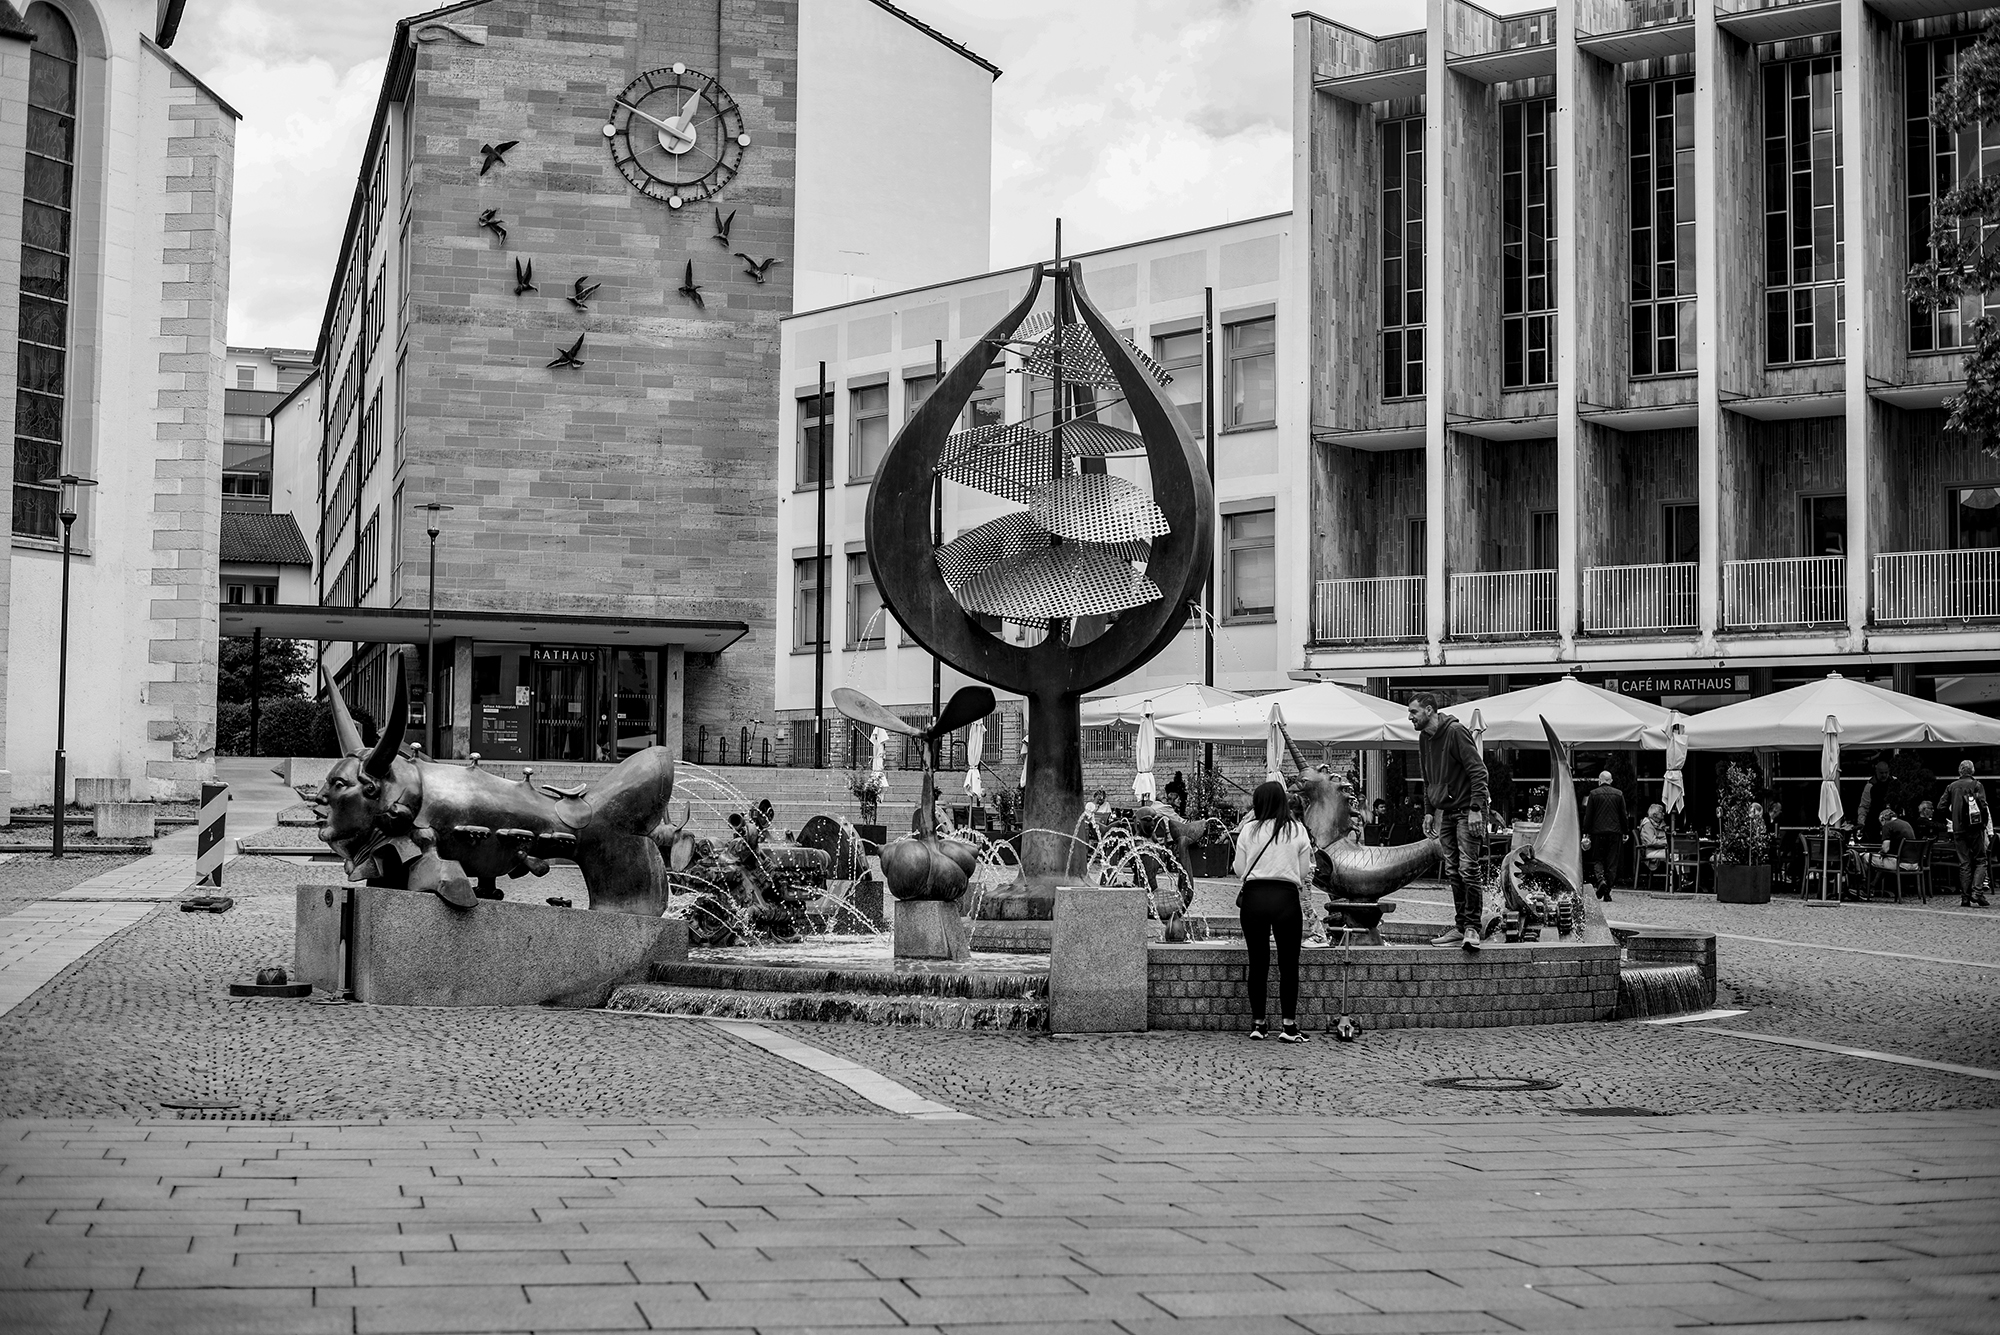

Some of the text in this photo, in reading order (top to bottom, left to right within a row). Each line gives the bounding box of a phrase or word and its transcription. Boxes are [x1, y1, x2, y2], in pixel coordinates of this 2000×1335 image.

[533, 650, 595, 661] RATHAUS
[672, 671, 677, 680] 1
[1621, 677, 1732, 692] CAFÉ IM RATHAUS
